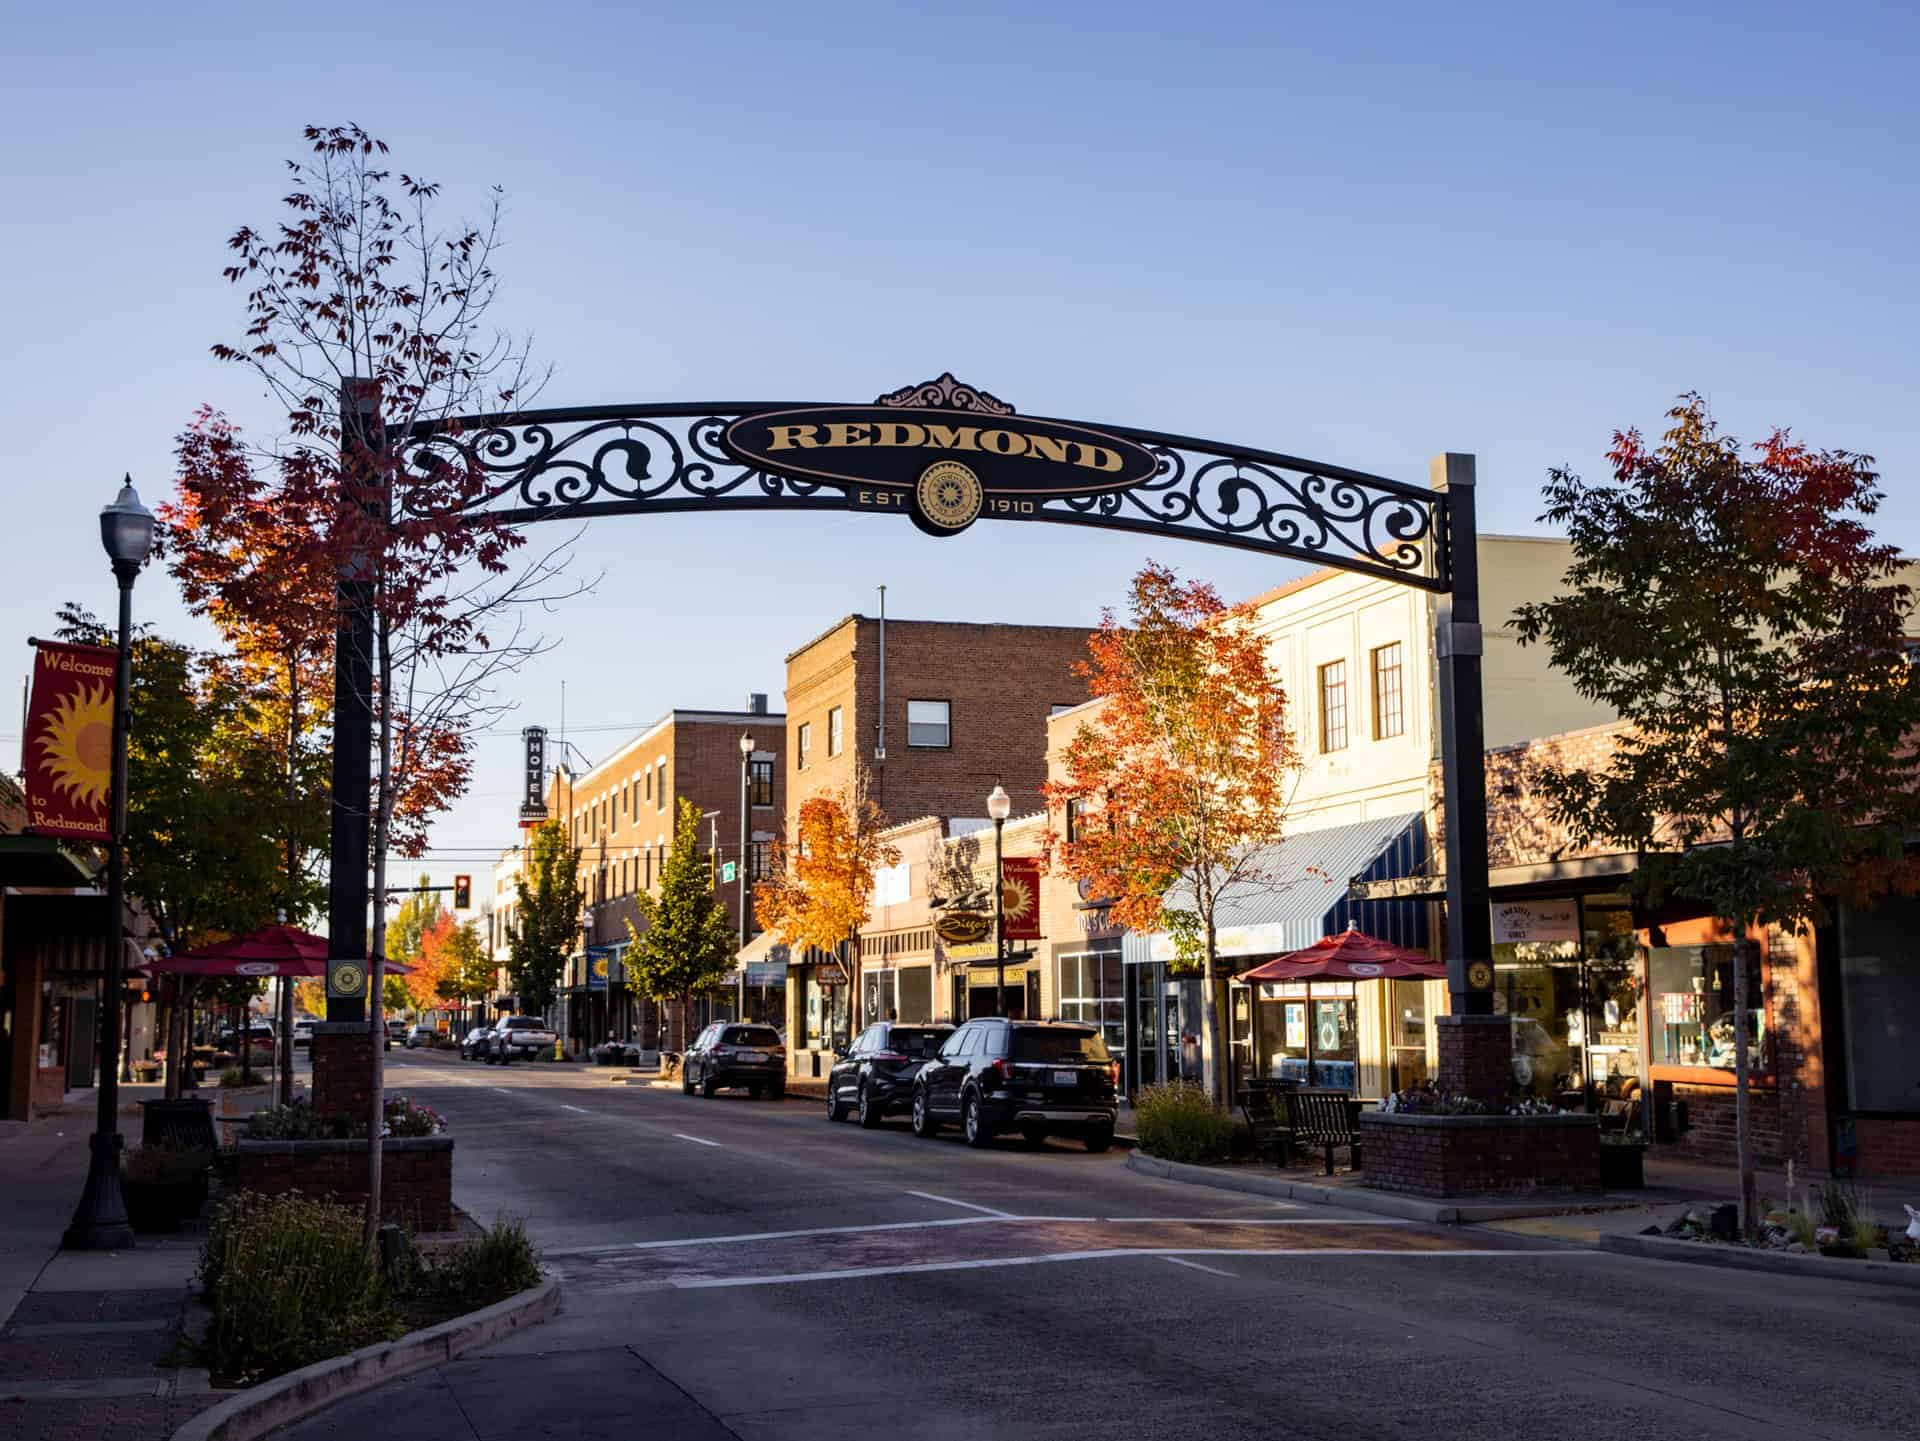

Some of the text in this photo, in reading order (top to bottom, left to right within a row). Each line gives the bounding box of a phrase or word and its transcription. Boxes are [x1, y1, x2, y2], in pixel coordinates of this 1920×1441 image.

[767, 422, 1123, 472] REDMOND
[859, 491, 1034, 513] EST 1910
[43, 650, 113, 677] Welcome
[527, 742, 541, 806] HOTEL
[32, 793, 47, 807] to
[33, 811, 107, 832] Redmond!
